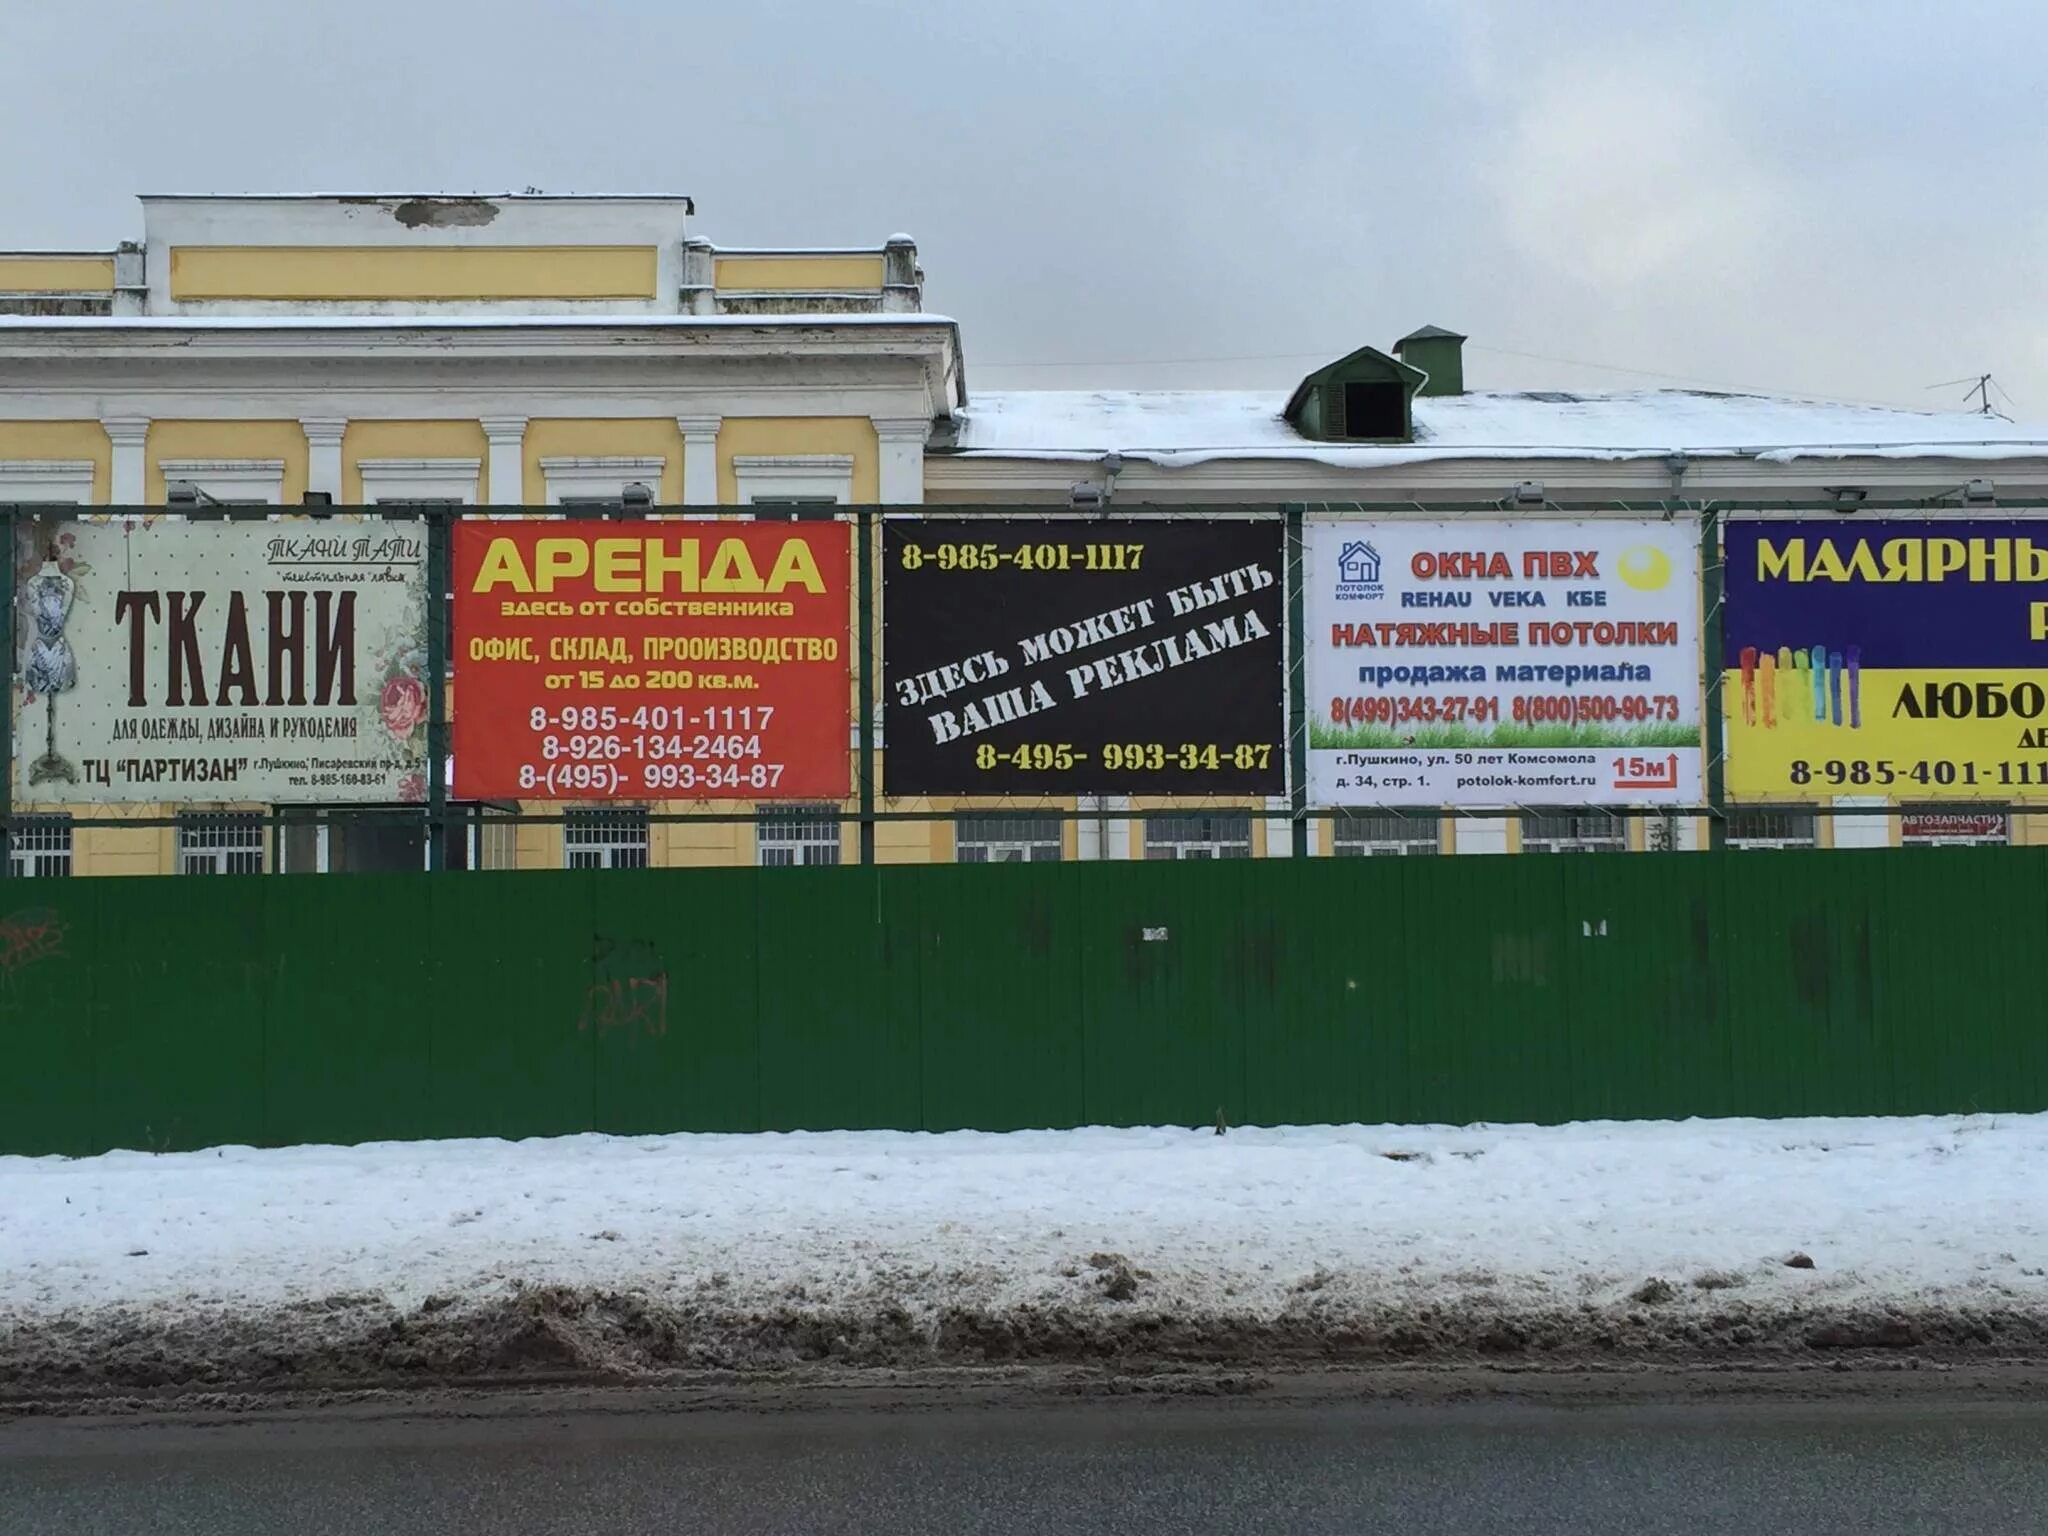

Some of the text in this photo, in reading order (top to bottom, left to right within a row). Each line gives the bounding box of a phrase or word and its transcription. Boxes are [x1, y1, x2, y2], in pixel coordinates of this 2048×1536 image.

[267, 538, 421, 561] ТКАНИ ТАТИ
[899, 541, 1145, 571] 8-985-401-1117
[473, 537, 827, 593] АРЕНДА
[1411, 551, 1600, 579] ОКНА ПВХ
[1336, 584, 1384, 592] ПОТОЛОК
[1336, 592, 1384, 600] КОМФОРТ
[1401, 591, 1472, 608] REHAU
[1488, 591, 1546, 608] VEKA
[501, 597, 794, 617] здесь от собственника
[896, 563, 1274, 706] ЗДЕСЬ МОЖЕТ БЫТЬ
[1331, 621, 1678, 648] НАТЯЖНЫЕ ПОТОЛКИ
[115, 590, 357, 707] ТКАНИ
[470, 637, 838, 664] ОФИС, СКЛАД, ПРООИЗВОДСТВО
[544, 670, 760, 690] от 15 до 200 кв.м.
[927, 609, 1271, 745] ВАША РЕКЛАМА
[1358, 663, 1651, 688] продажа материала
[1331, 696, 1680, 728] 8(499)343-27-91 8(800)500-90-73
[1892, 682, 2046, 719] ЛЮБО
[113, 713, 357, 742] ДЛЯ ОДЕЖДЫ, ДИЗАЙНА И РУКОДЕЛИЯ
[529, 706, 775, 731] 8-985-401-1117
[542, 735, 762, 760] 8-926-134-2464
[975, 743, 1273, 770] 8-495- 993-34-87
[1336, 753, 1596, 768] г.Пушкино, ул. 50 лет Комсомола
[82, 759, 111, 788] ТЦ
[518, 763, 785, 795] 8-(495)- 993-34-87
[1612, 757, 1665, 778] 15м
[1336, 775, 1431, 789] д. 34, стр. 1.
[1457, 774, 1596, 789] potolok-komfort.ru
[1902, 814, 1996, 825] АВТОЗАПЧАСТИ
